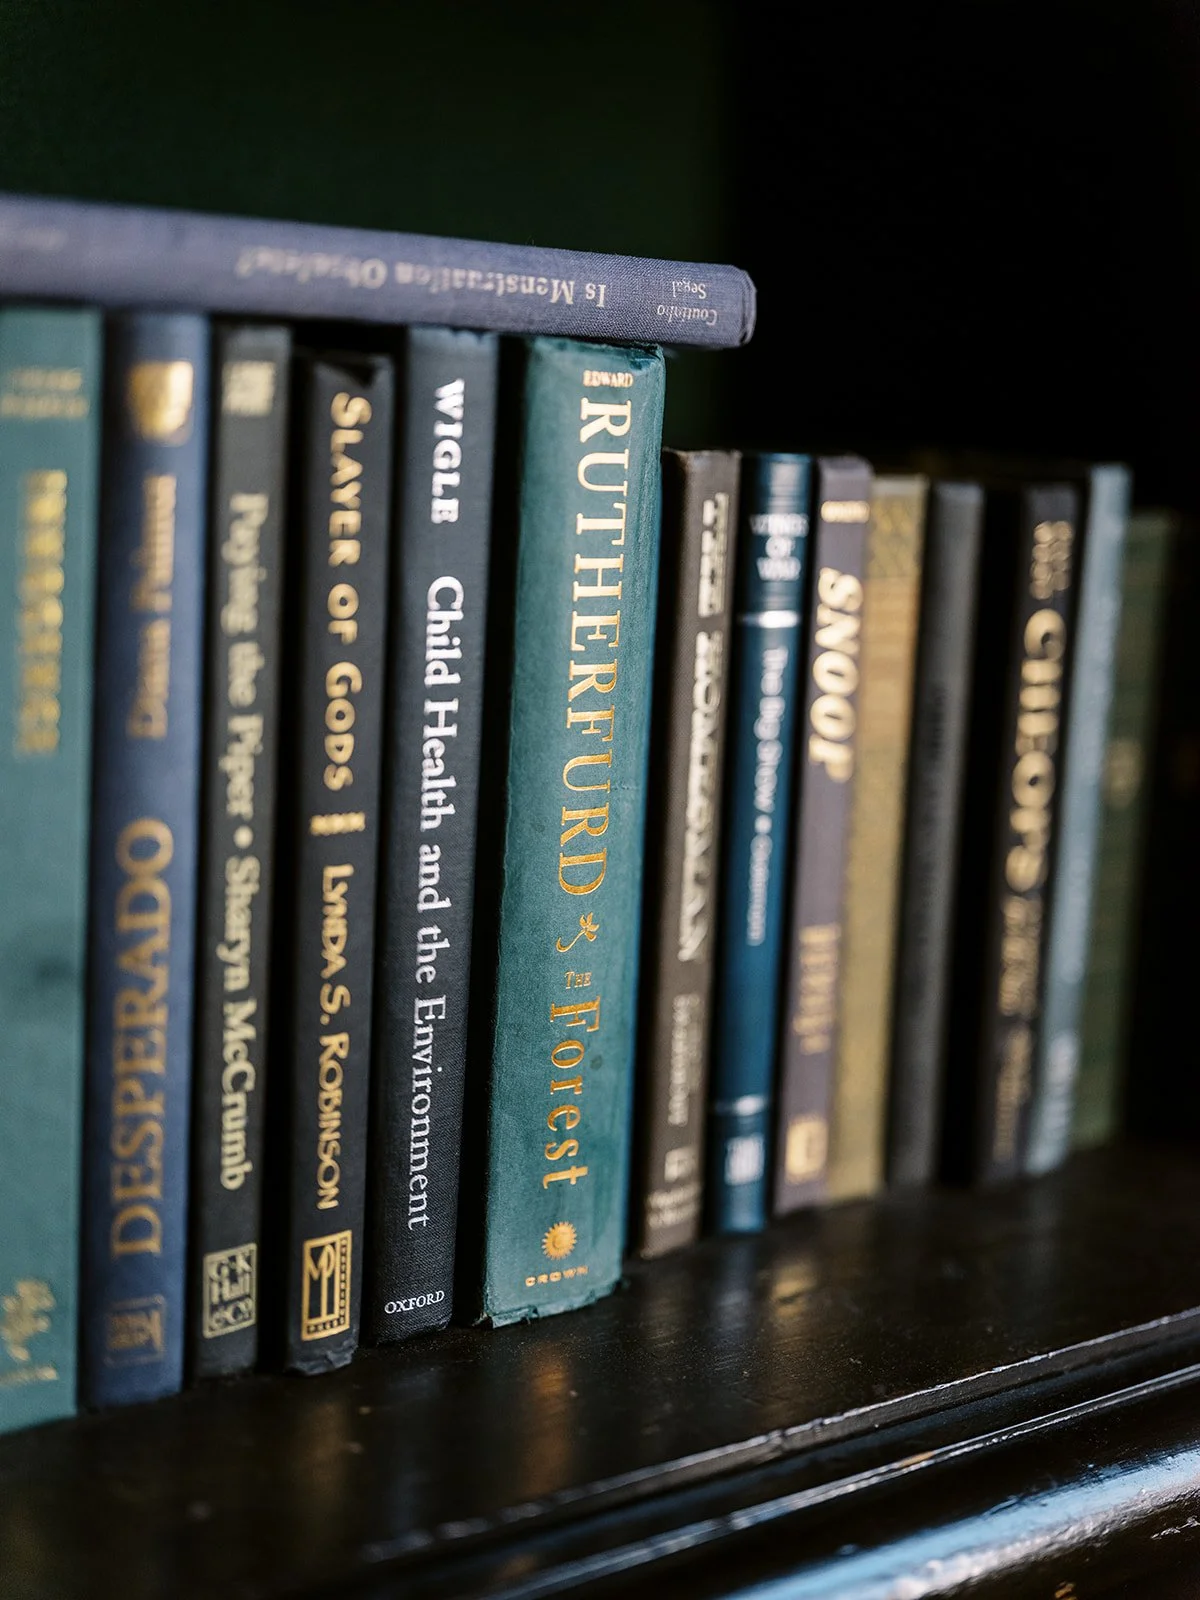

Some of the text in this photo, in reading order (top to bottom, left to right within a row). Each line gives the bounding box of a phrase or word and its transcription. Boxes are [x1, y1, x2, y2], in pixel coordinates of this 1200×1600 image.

[586, 283, 607, 307] Is
[656, 304, 718, 326] Coutinho
[671, 277, 707, 300] Segal
[583, 369, 634, 388] EDWARD
[431, 379, 465, 524] WIGLE
[324, 393, 372, 791] SLAYER OF GODS
[558, 397, 632, 896] RUTHERFURD
[228, 641, 265, 706] the
[219, 715, 264, 819] Piper
[408, 575, 465, 1231] Child Health and the Environment
[110, 817, 175, 1254] DESPERADO
[216, 855, 261, 1190] Sharyn McCrumb
[317, 864, 355, 1210] LYNDA S. ROBINSON
[543, 970, 601, 1190] THE Forest
[384, 1290, 445, 1314] OXFORD
[526, 1266, 589, 1288] CROWN
